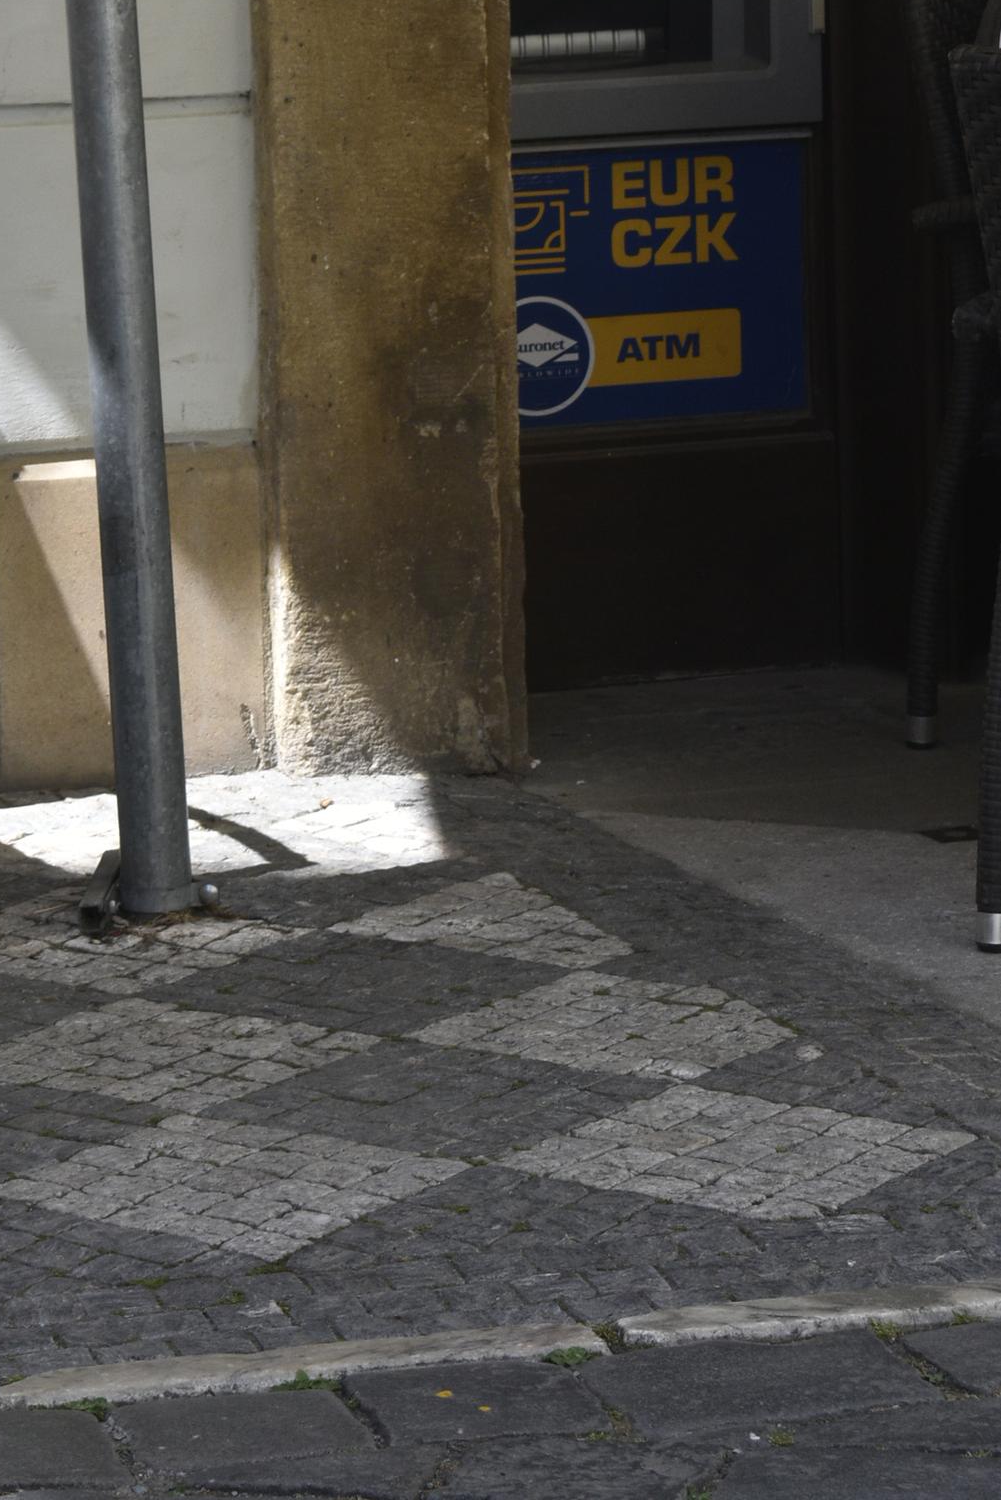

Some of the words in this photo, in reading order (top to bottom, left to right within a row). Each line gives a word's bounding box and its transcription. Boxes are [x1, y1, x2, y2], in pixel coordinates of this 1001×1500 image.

[611, 155, 735, 210] EUR
[611, 212, 739, 269] CZK
[518, 340, 565, 353] uronet
[616, 333, 700, 363] ATM
